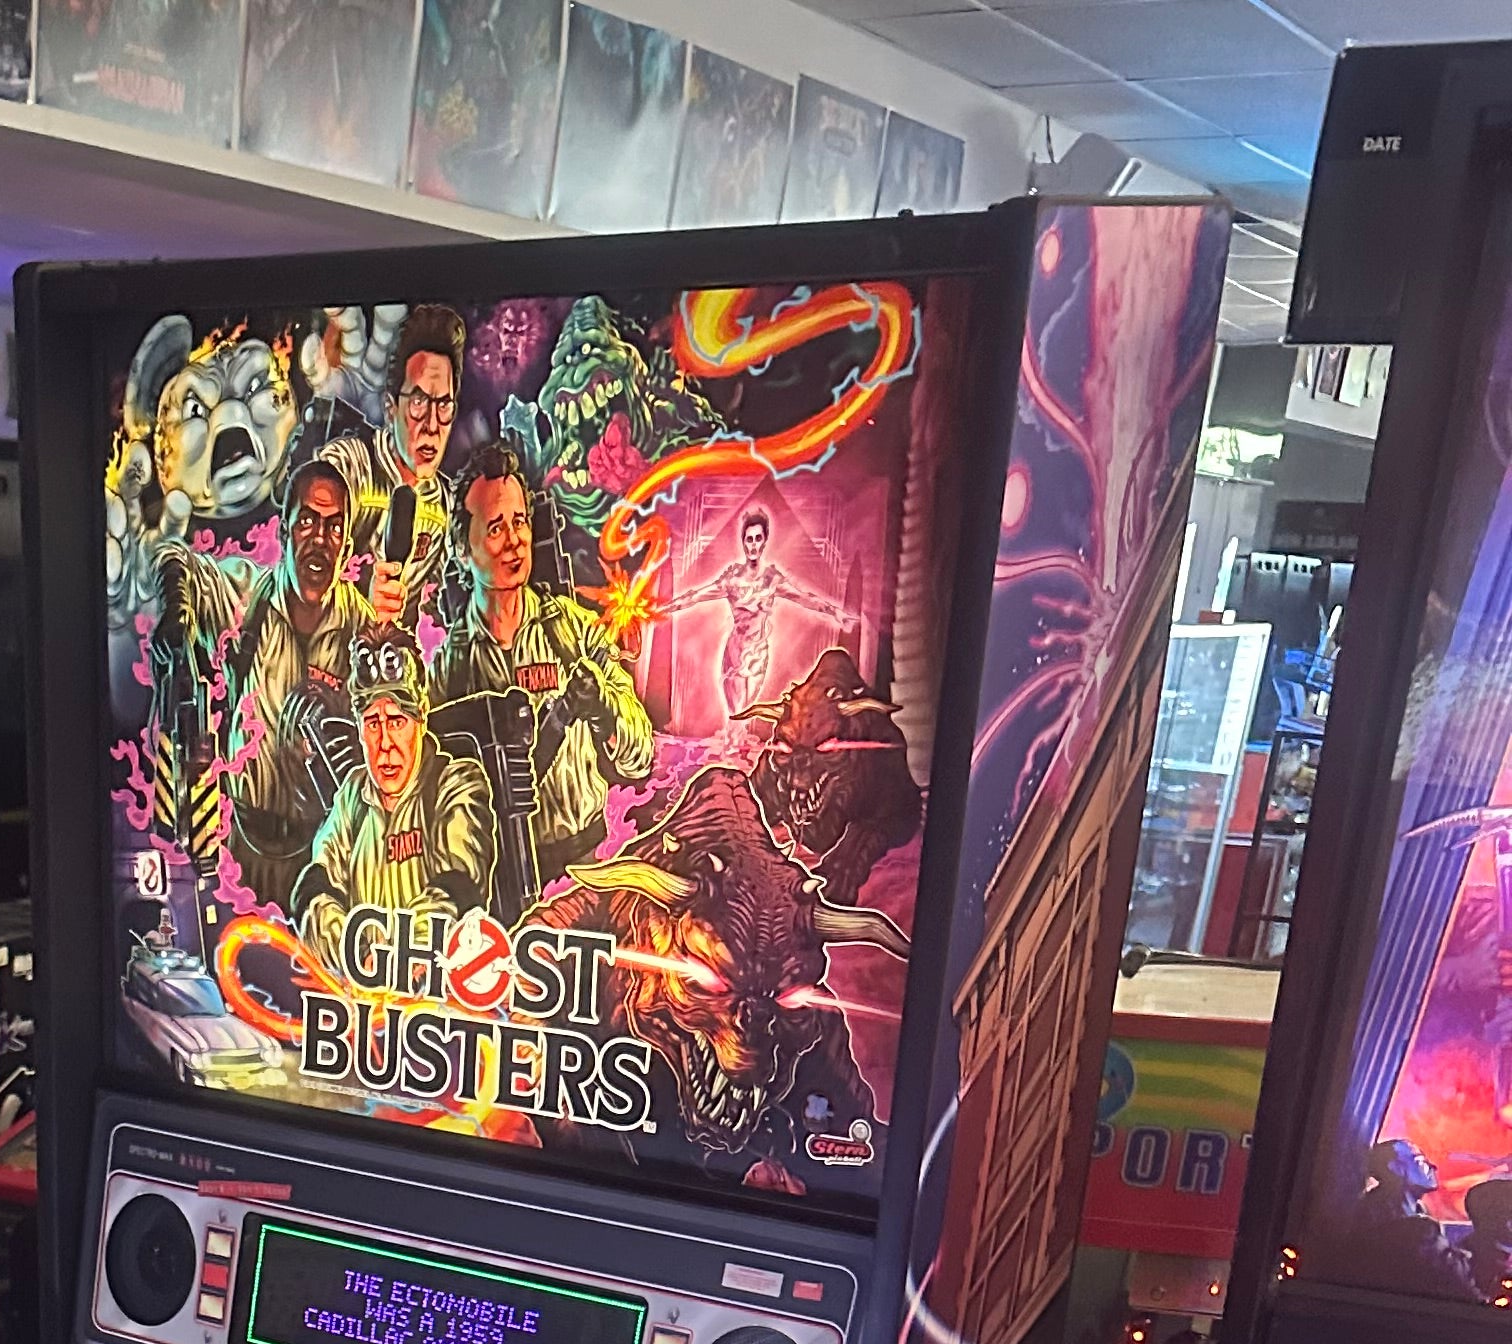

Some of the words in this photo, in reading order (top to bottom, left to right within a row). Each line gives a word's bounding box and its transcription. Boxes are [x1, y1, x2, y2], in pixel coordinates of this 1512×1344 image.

[1362, 136, 1402, 153] DATE
[300, 991, 652, 1132] BUSTERS
[813, 1140, 868, 1156] Stern
[345, 1269, 384, 1298] THE
[390, 1280, 540, 1335] ECTOMOBILE
[365, 1299, 412, 1328] WAS
[419, 1312, 435, 1334] A
